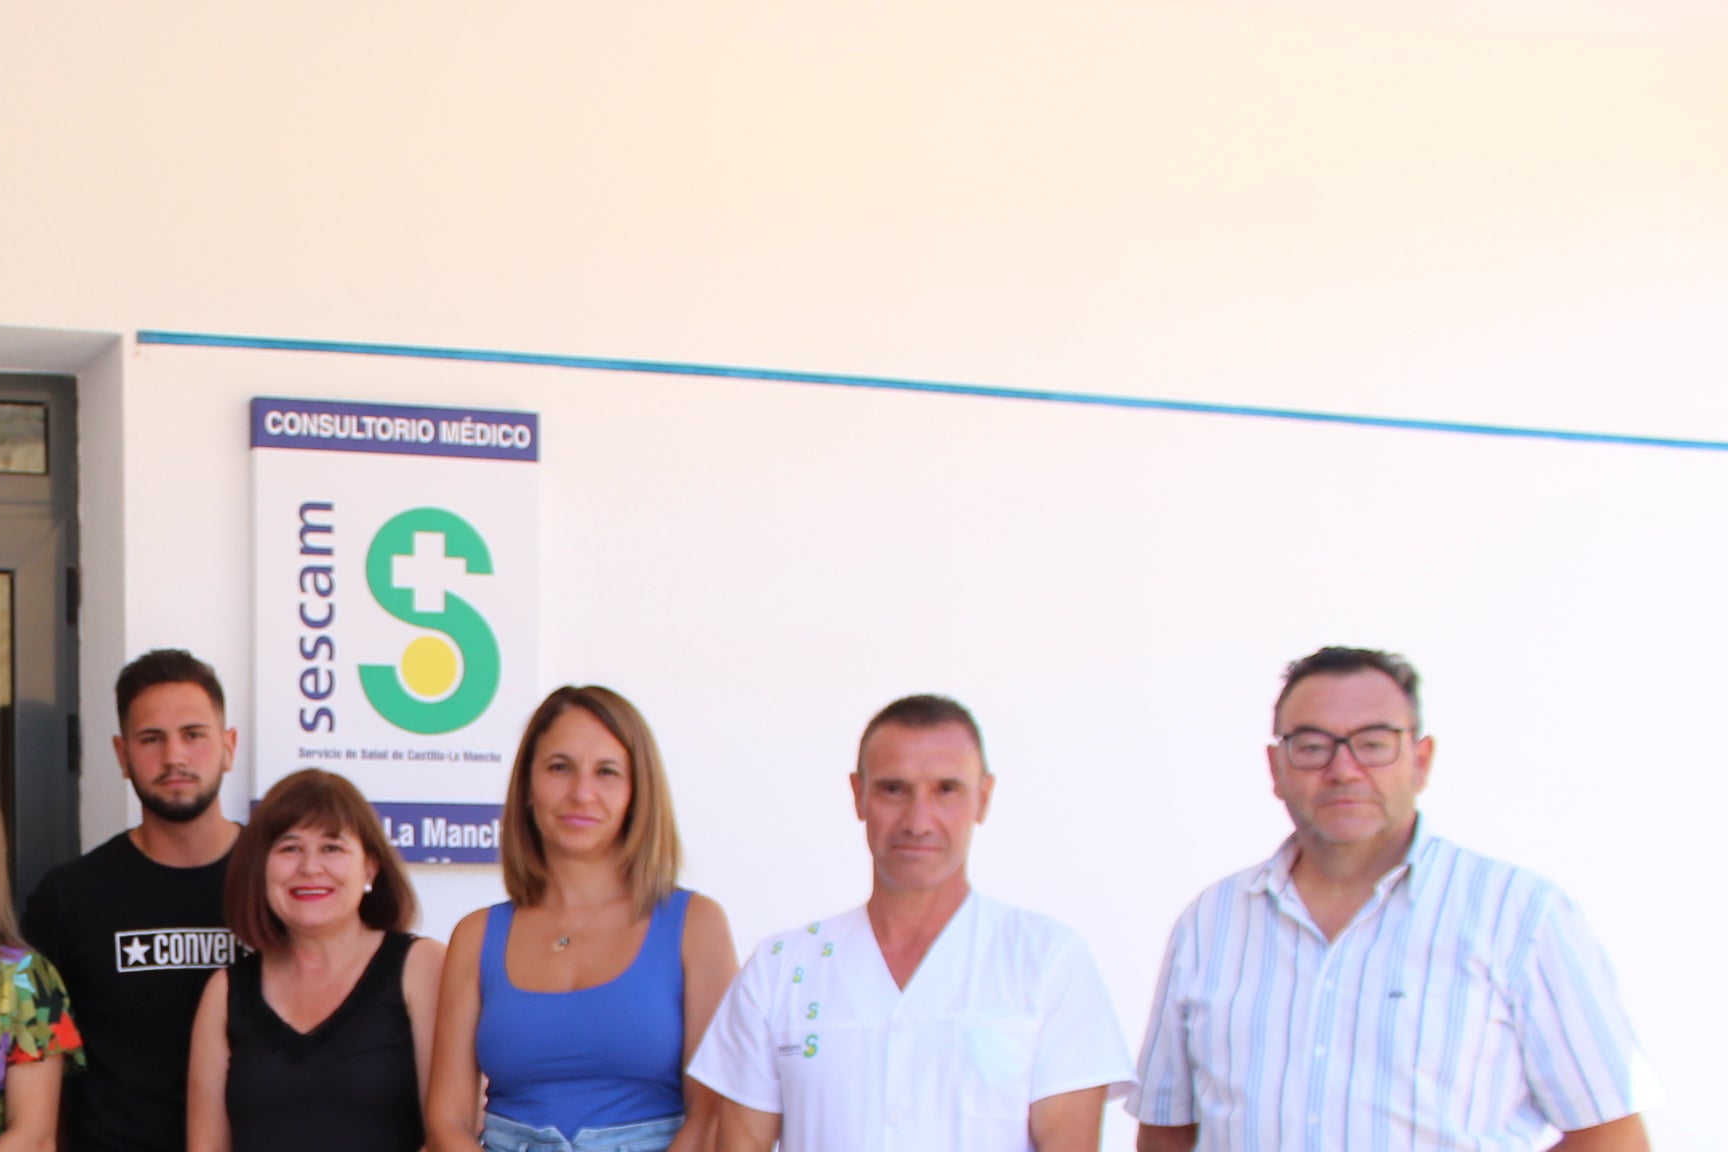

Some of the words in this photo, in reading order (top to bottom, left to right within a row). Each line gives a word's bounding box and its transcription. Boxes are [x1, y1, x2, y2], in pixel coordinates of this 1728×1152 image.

[264, 410, 435, 443] CONSULTORIO
[439, 415, 532, 449] MÉDICO
[298, 500, 335, 733] sescam
[298, 747, 342, 759] Servicio
[345, 748, 357, 759] de
[360, 748, 389, 760] Salud
[392, 750, 403, 761] de
[463, 750, 502, 762] Mancha
[423, 816, 503, 849] Manch
